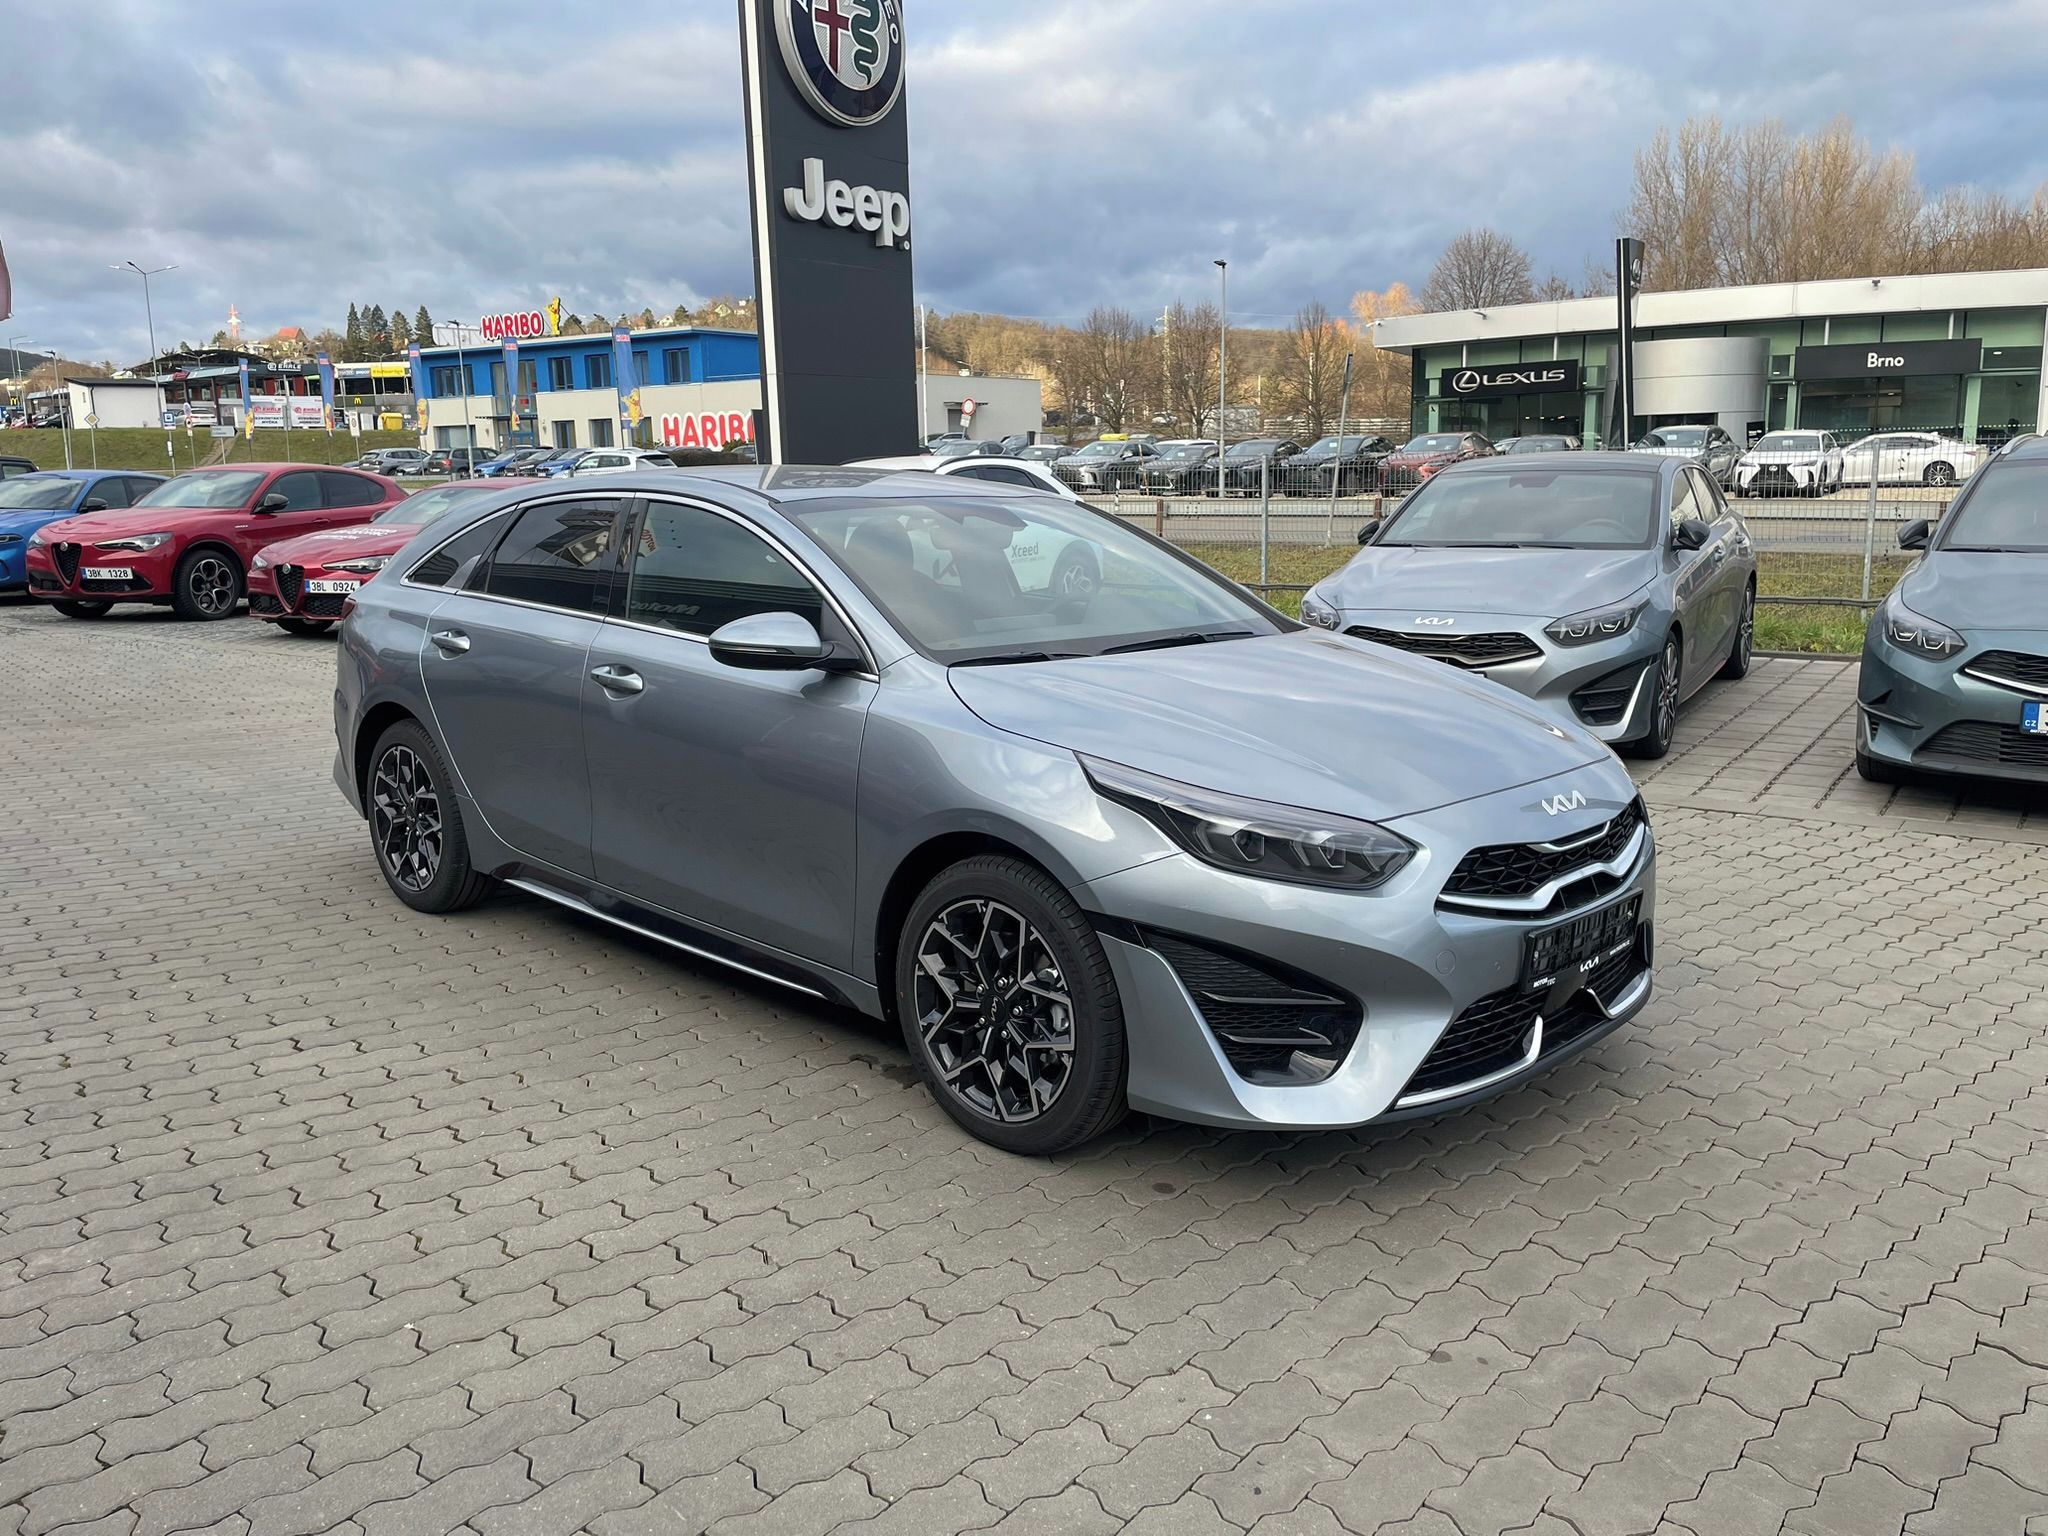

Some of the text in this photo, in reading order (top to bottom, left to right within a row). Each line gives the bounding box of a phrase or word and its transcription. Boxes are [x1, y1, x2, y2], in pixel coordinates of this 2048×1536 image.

[783, 157, 909, 247] Jeep
[481, 311, 542, 339] HARIBO
[1867, 352, 1904, 368] Brno
[1482, 369, 1565, 386] LEXUS
[1011, 543, 1039, 558] Xceed
[87, 569, 129, 578] 3BK 1328
[311, 580, 356, 592] 3BL 0924
[1414, 616, 1454, 625] KIA
[2024, 719, 2037, 727] CZ
[1541, 790, 1586, 816] KIA
[1580, 956, 1599, 973] KIA
